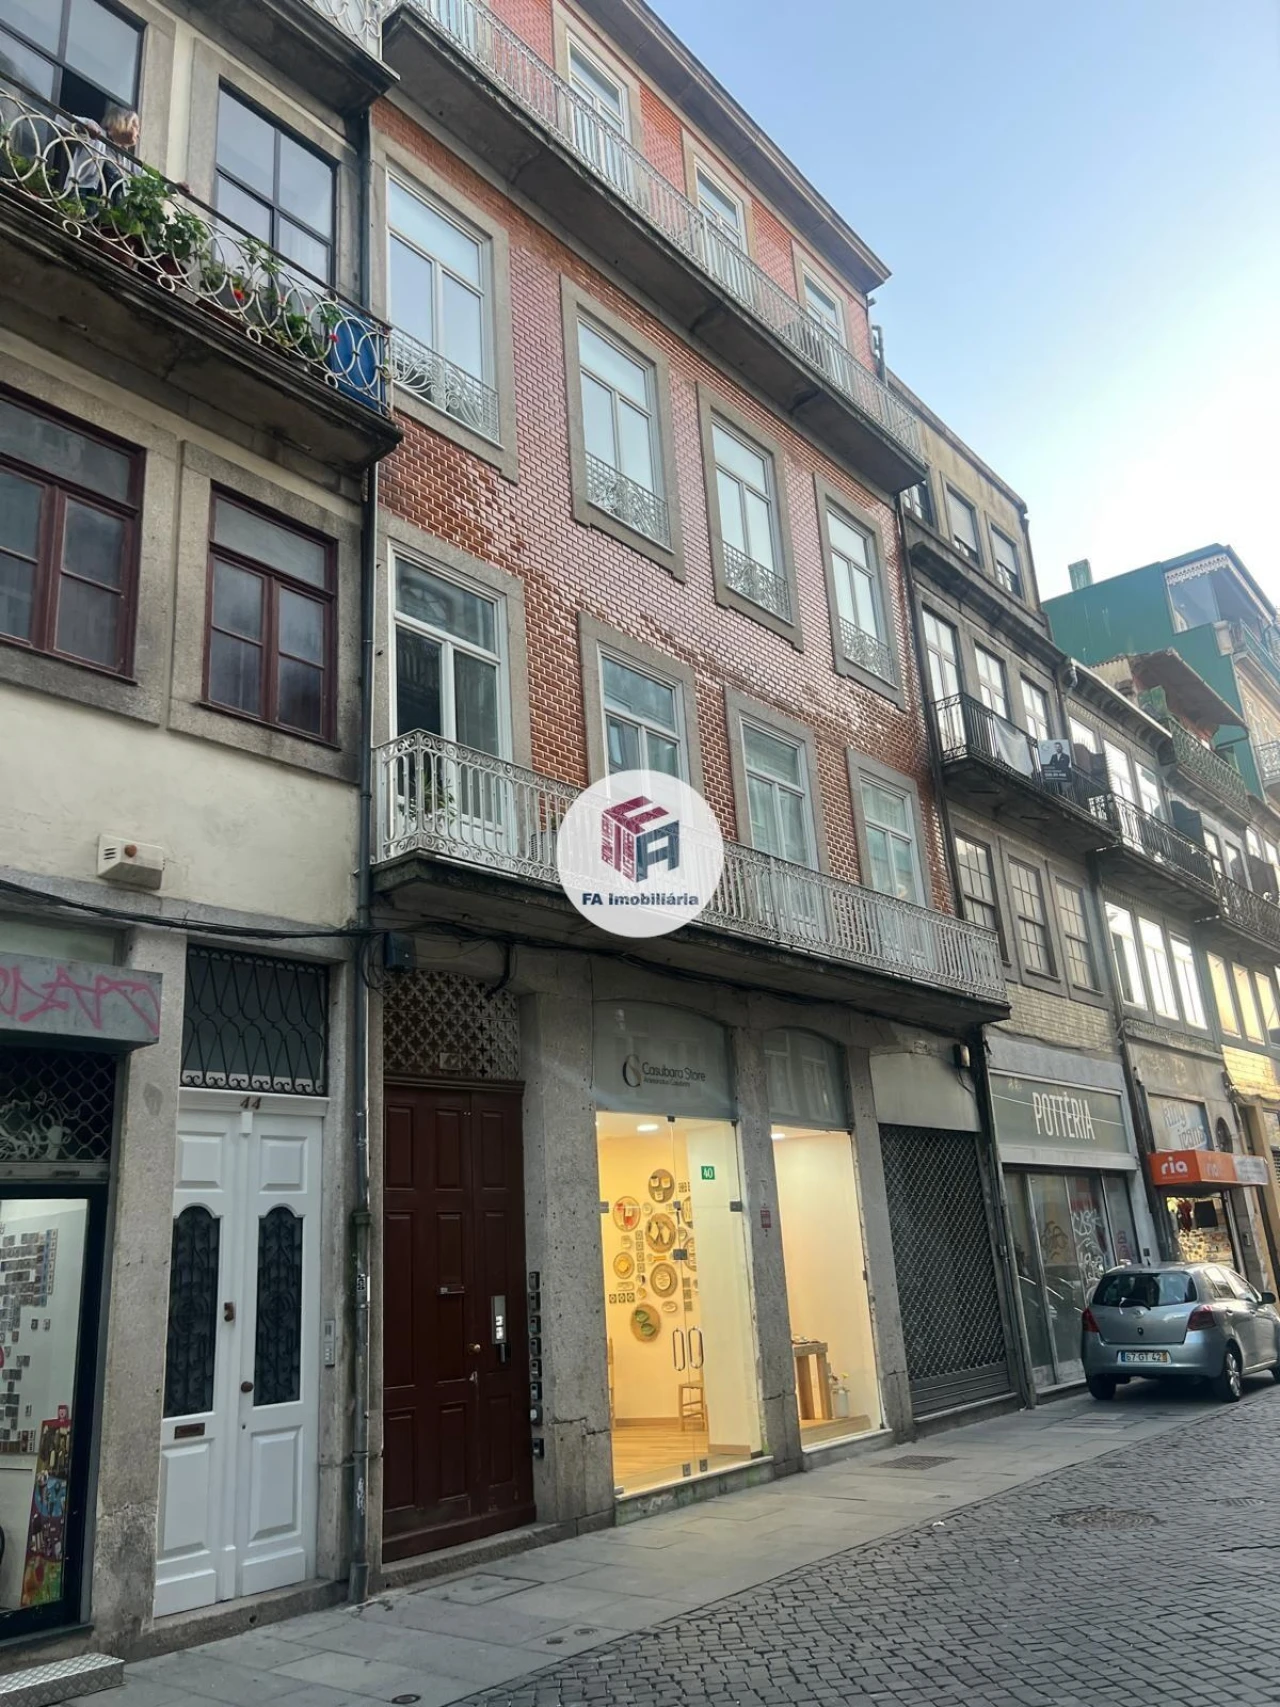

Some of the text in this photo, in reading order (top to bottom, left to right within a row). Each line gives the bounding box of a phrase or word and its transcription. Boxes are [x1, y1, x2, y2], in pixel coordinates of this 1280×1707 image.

[684, 1067, 706, 1082] Store
[240, 1096, 262, 1110] 44
[1161, 1156, 1188, 1175] ria
[703, 1167, 714, 1179] 40
